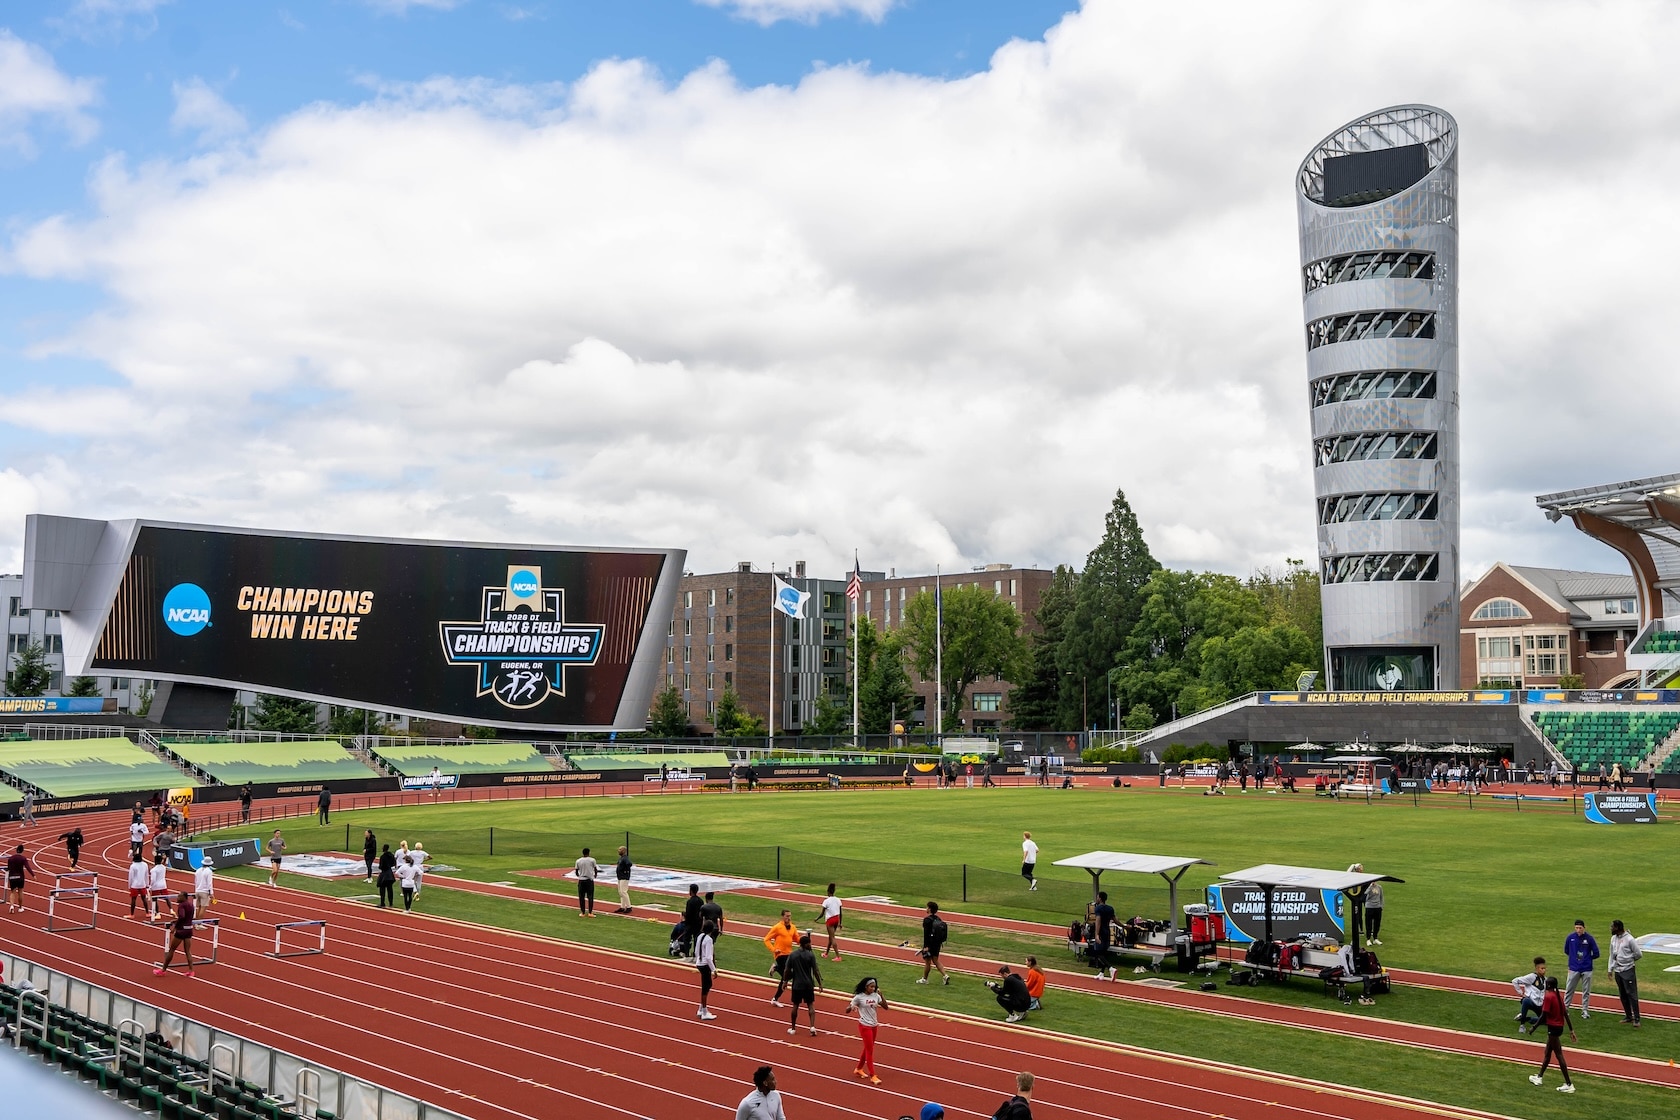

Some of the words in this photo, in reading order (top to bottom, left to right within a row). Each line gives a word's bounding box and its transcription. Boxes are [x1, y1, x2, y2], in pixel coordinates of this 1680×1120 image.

[513, 583, 537, 591] NCAA
[237, 585, 375, 615] CHAMPIONS
[168, 608, 209, 623] NCAA
[250, 613, 297, 639] WIN
[301, 616, 361, 641] HERE
[484, 621, 520, 634] TRACK
[520, 622, 530, 633] &
[531, 622, 562, 634] FIELD
[454, 635, 591, 654] CHAMPIONSHIPS
[1306, 693, 1329, 703] NCAA
[1338, 693, 1364, 702] TRACK
[1364, 693, 1381, 702] AND
[1382, 693, 1403, 702] FIELD
[1403, 692, 1469, 702] CHAMPIONSHIPS
[403, 775, 455, 786] CHAMPIOHIPS
[503, 775, 524, 783] DIVISION
[562, 773, 601, 781] CHAMPIONSHIPS
[1244, 892, 1266, 902] TRAC
[1273, 892, 1280, 902] &
[1282, 892, 1306, 902] FIELD
